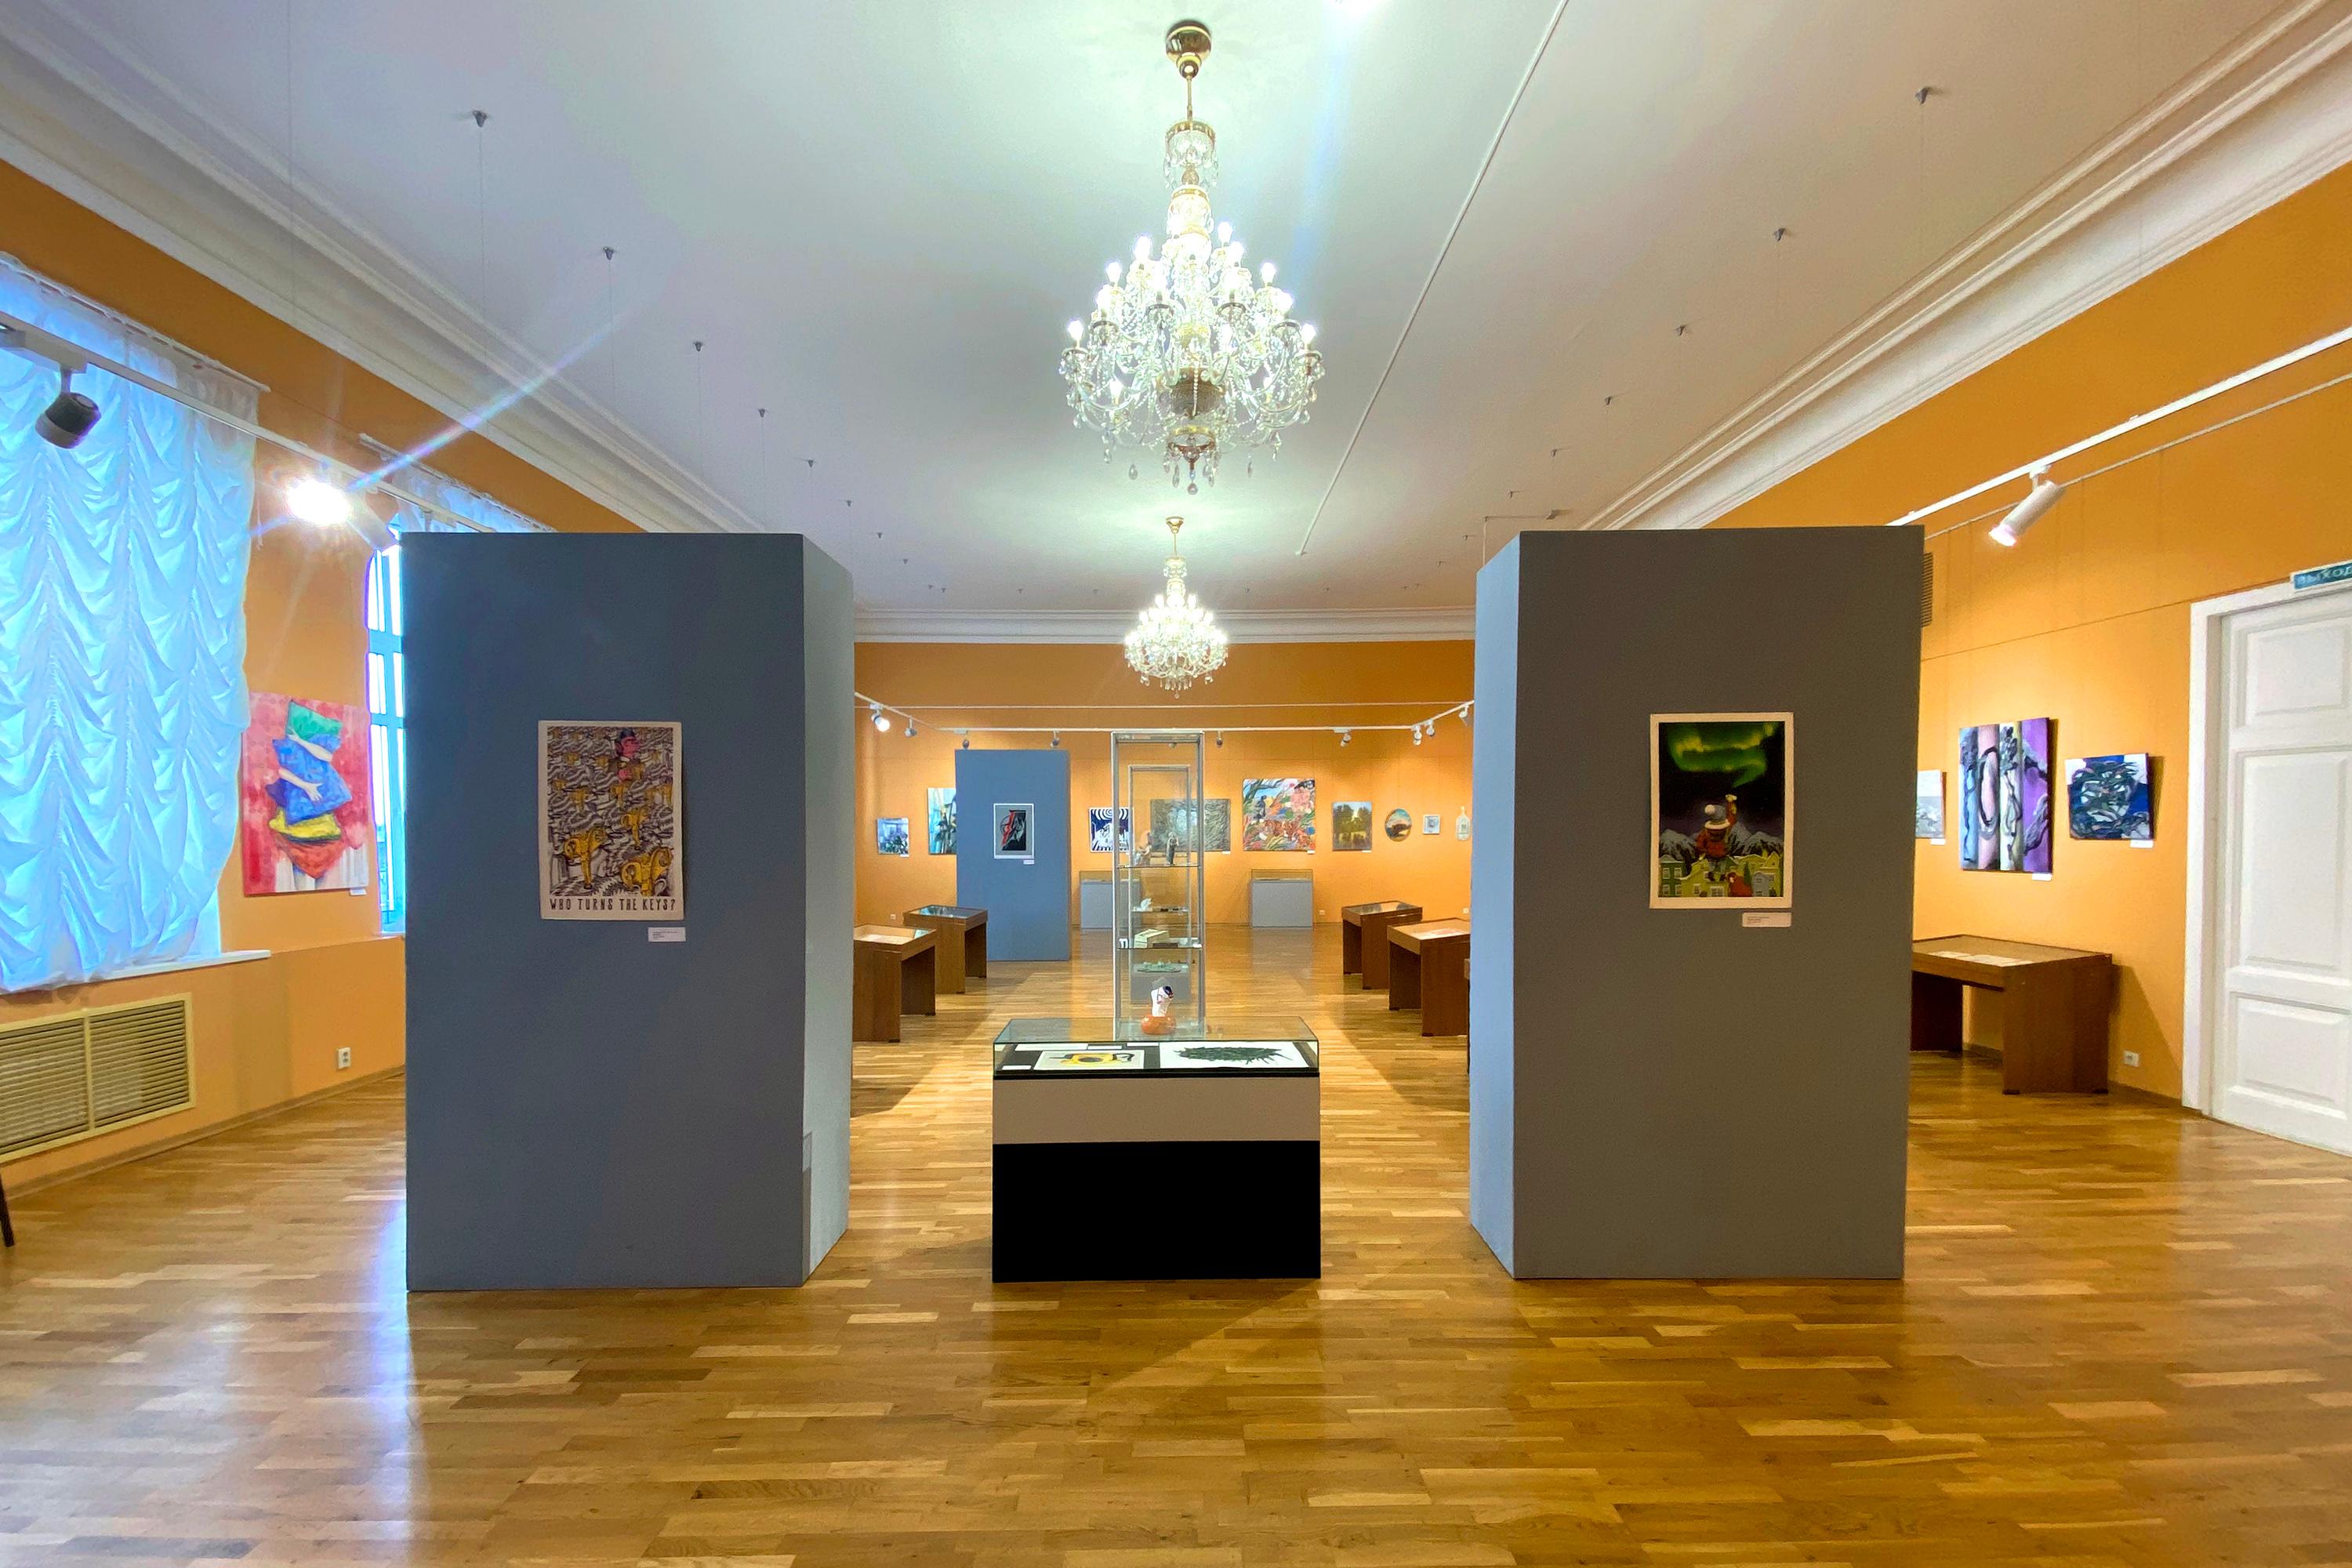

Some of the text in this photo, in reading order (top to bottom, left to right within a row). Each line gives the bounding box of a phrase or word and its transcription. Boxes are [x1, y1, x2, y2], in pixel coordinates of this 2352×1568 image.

[550, 898, 676, 911] WHO TURNS THE KEYS?
